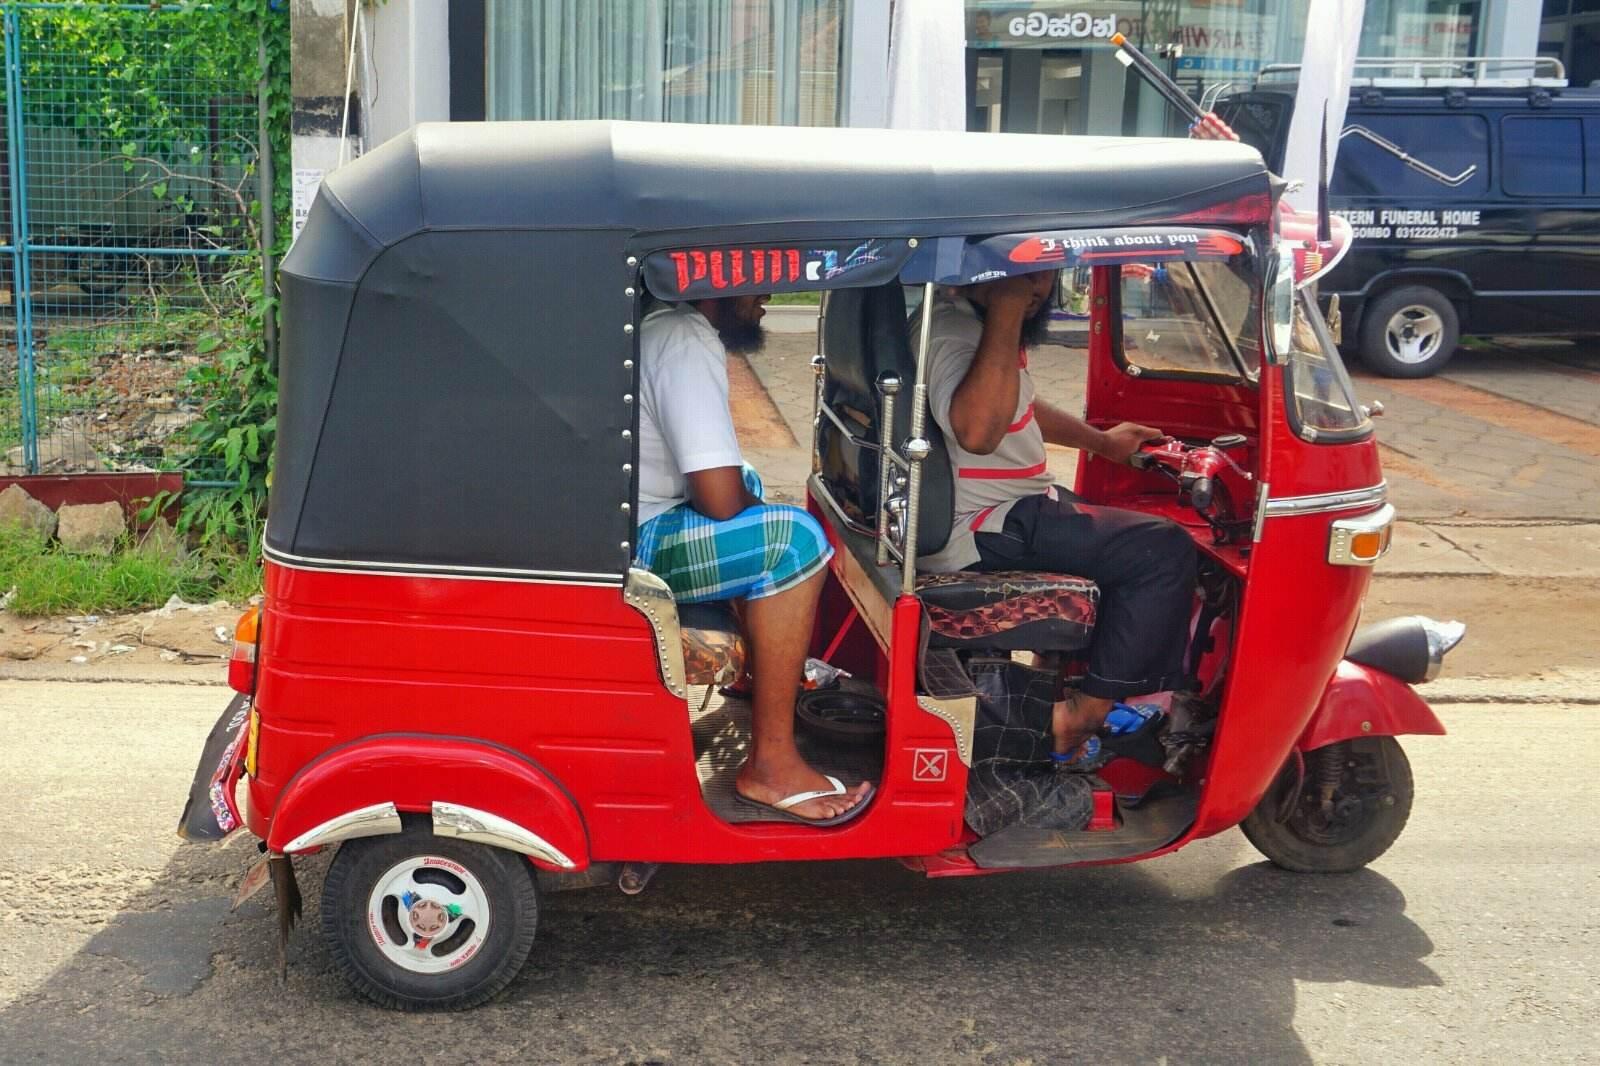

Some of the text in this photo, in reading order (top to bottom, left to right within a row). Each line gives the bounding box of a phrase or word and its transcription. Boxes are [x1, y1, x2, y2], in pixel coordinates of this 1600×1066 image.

[1380, 210, 1438, 225] FUNERAL
[1442, 210, 1481, 225] HOME
[1351, 227, 1392, 239] GOMBO
[1062, 235, 1110, 250] think
[1114, 234, 1164, 247] about
